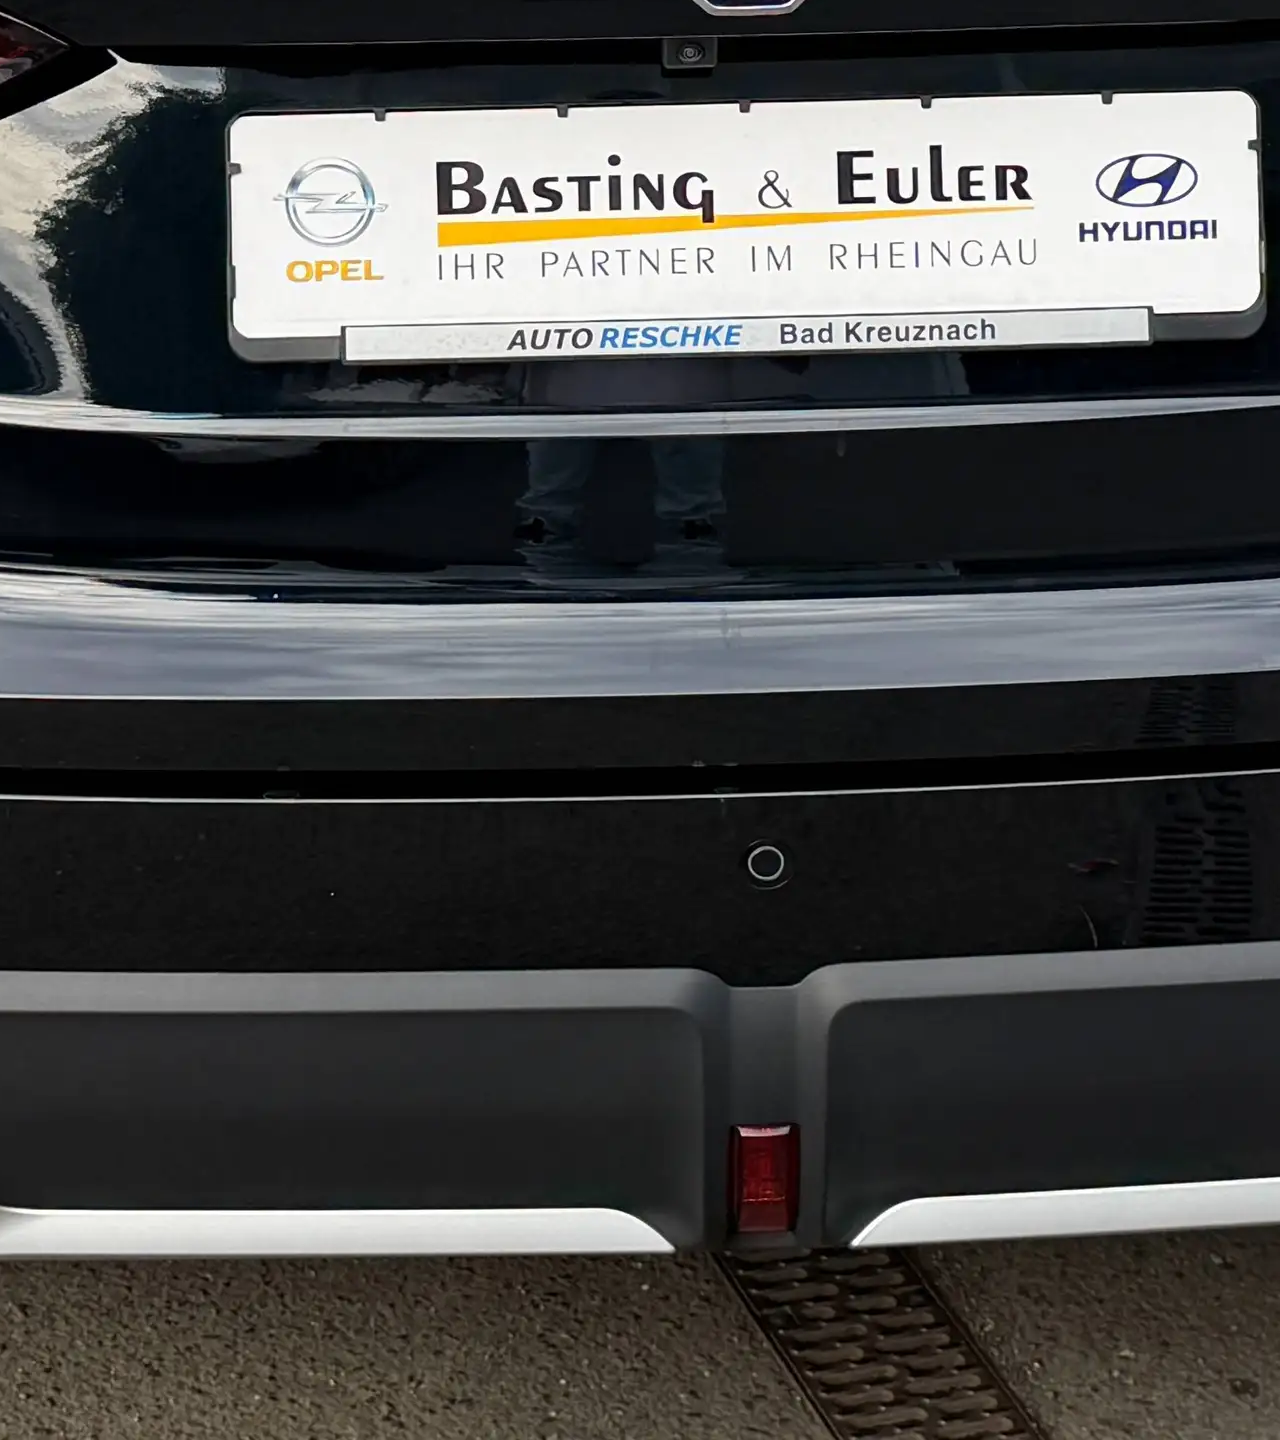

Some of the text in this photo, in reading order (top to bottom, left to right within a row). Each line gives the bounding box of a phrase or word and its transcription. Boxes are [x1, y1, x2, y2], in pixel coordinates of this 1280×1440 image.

[757, 169, 793, 209] &
[1078, 218, 1218, 243] HYUNDAI
[285, 259, 385, 282] OPEL
[437, 238, 1038, 281] IHR PARTNER IM RHEINGAU
[778, 320, 834, 345] Bad
[844, 318, 997, 344] Kreuznach
